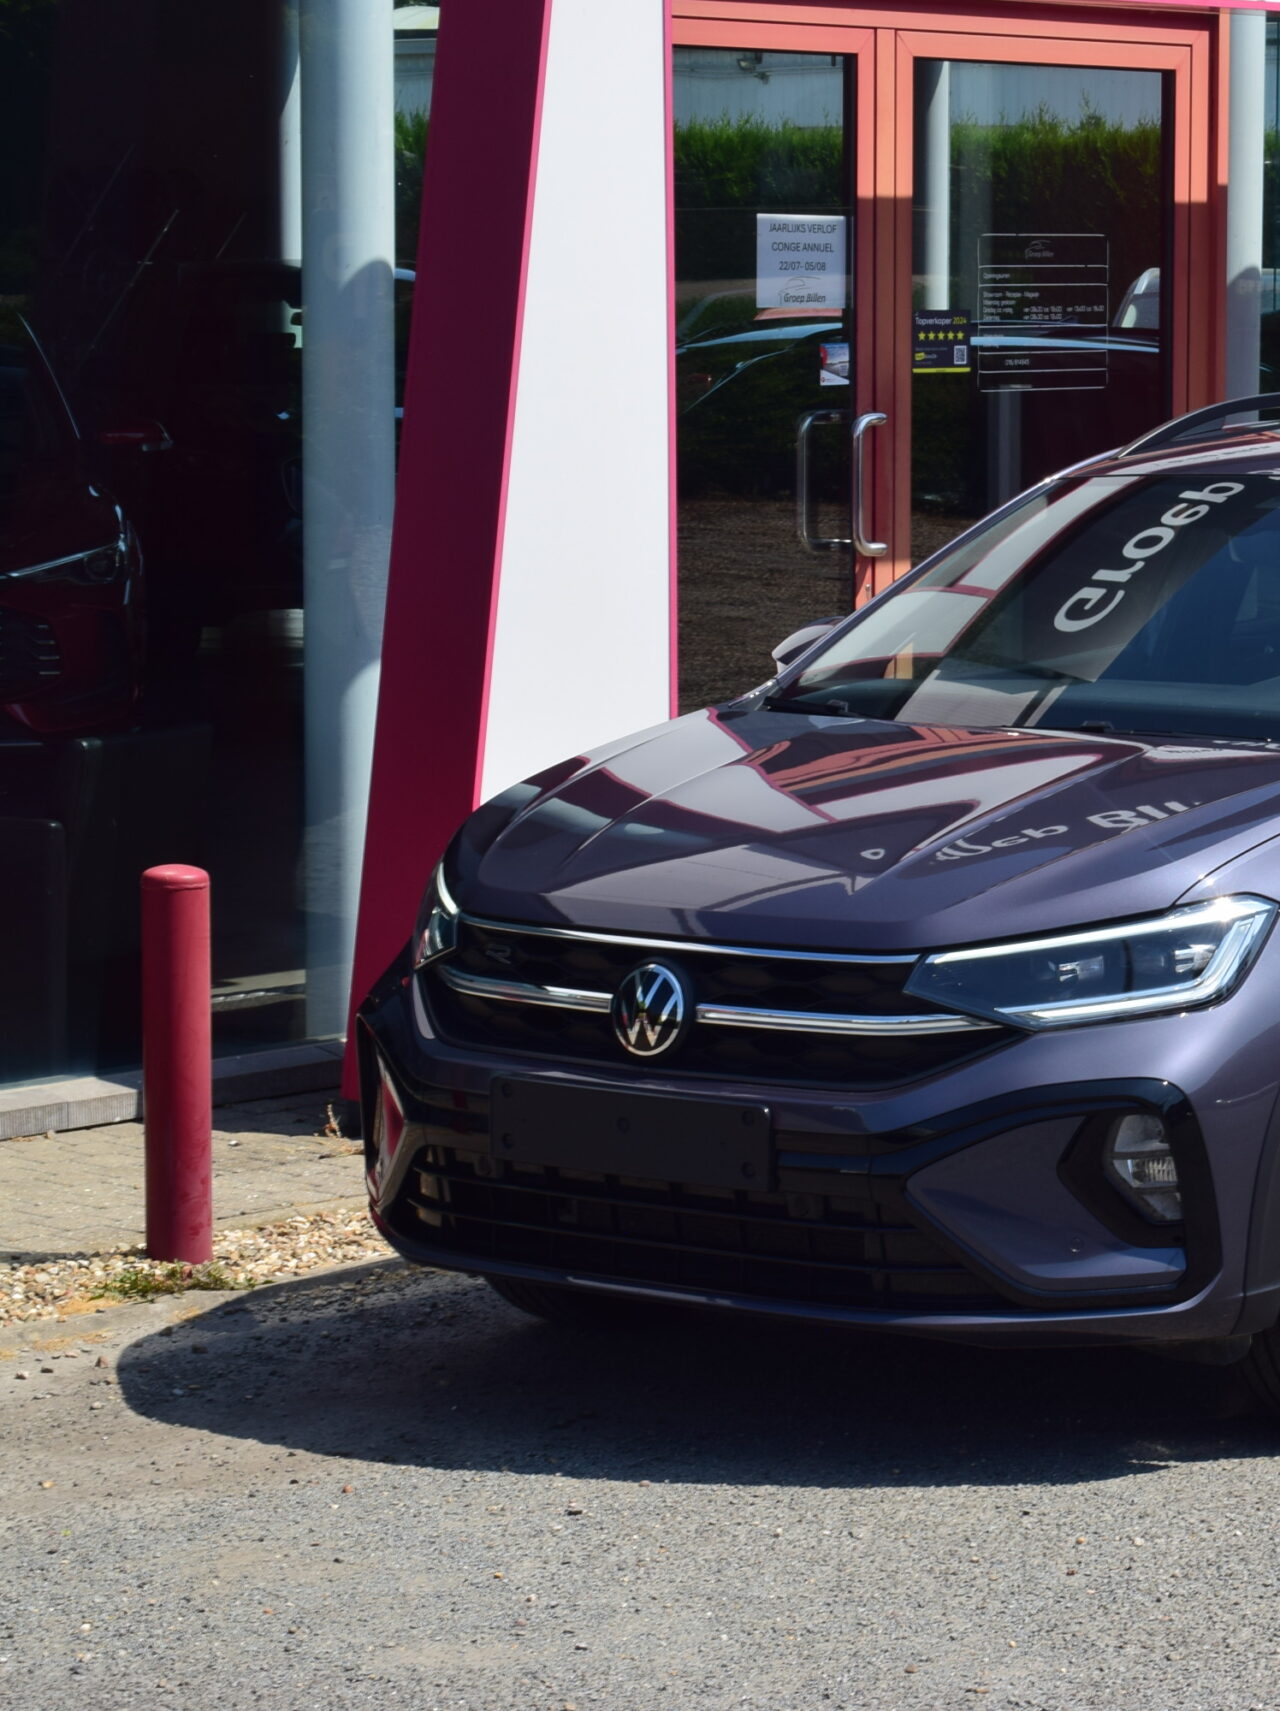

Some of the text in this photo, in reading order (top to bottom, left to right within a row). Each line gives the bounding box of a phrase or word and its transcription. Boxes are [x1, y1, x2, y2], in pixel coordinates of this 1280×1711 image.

[768, 223, 837, 234] JAARLIJKS VERLOF
[771, 242, 834, 253] CONGE ANNUEL
[805, 262, 826, 271] 05/08
[783, 293, 826, 304] Groep Billen
